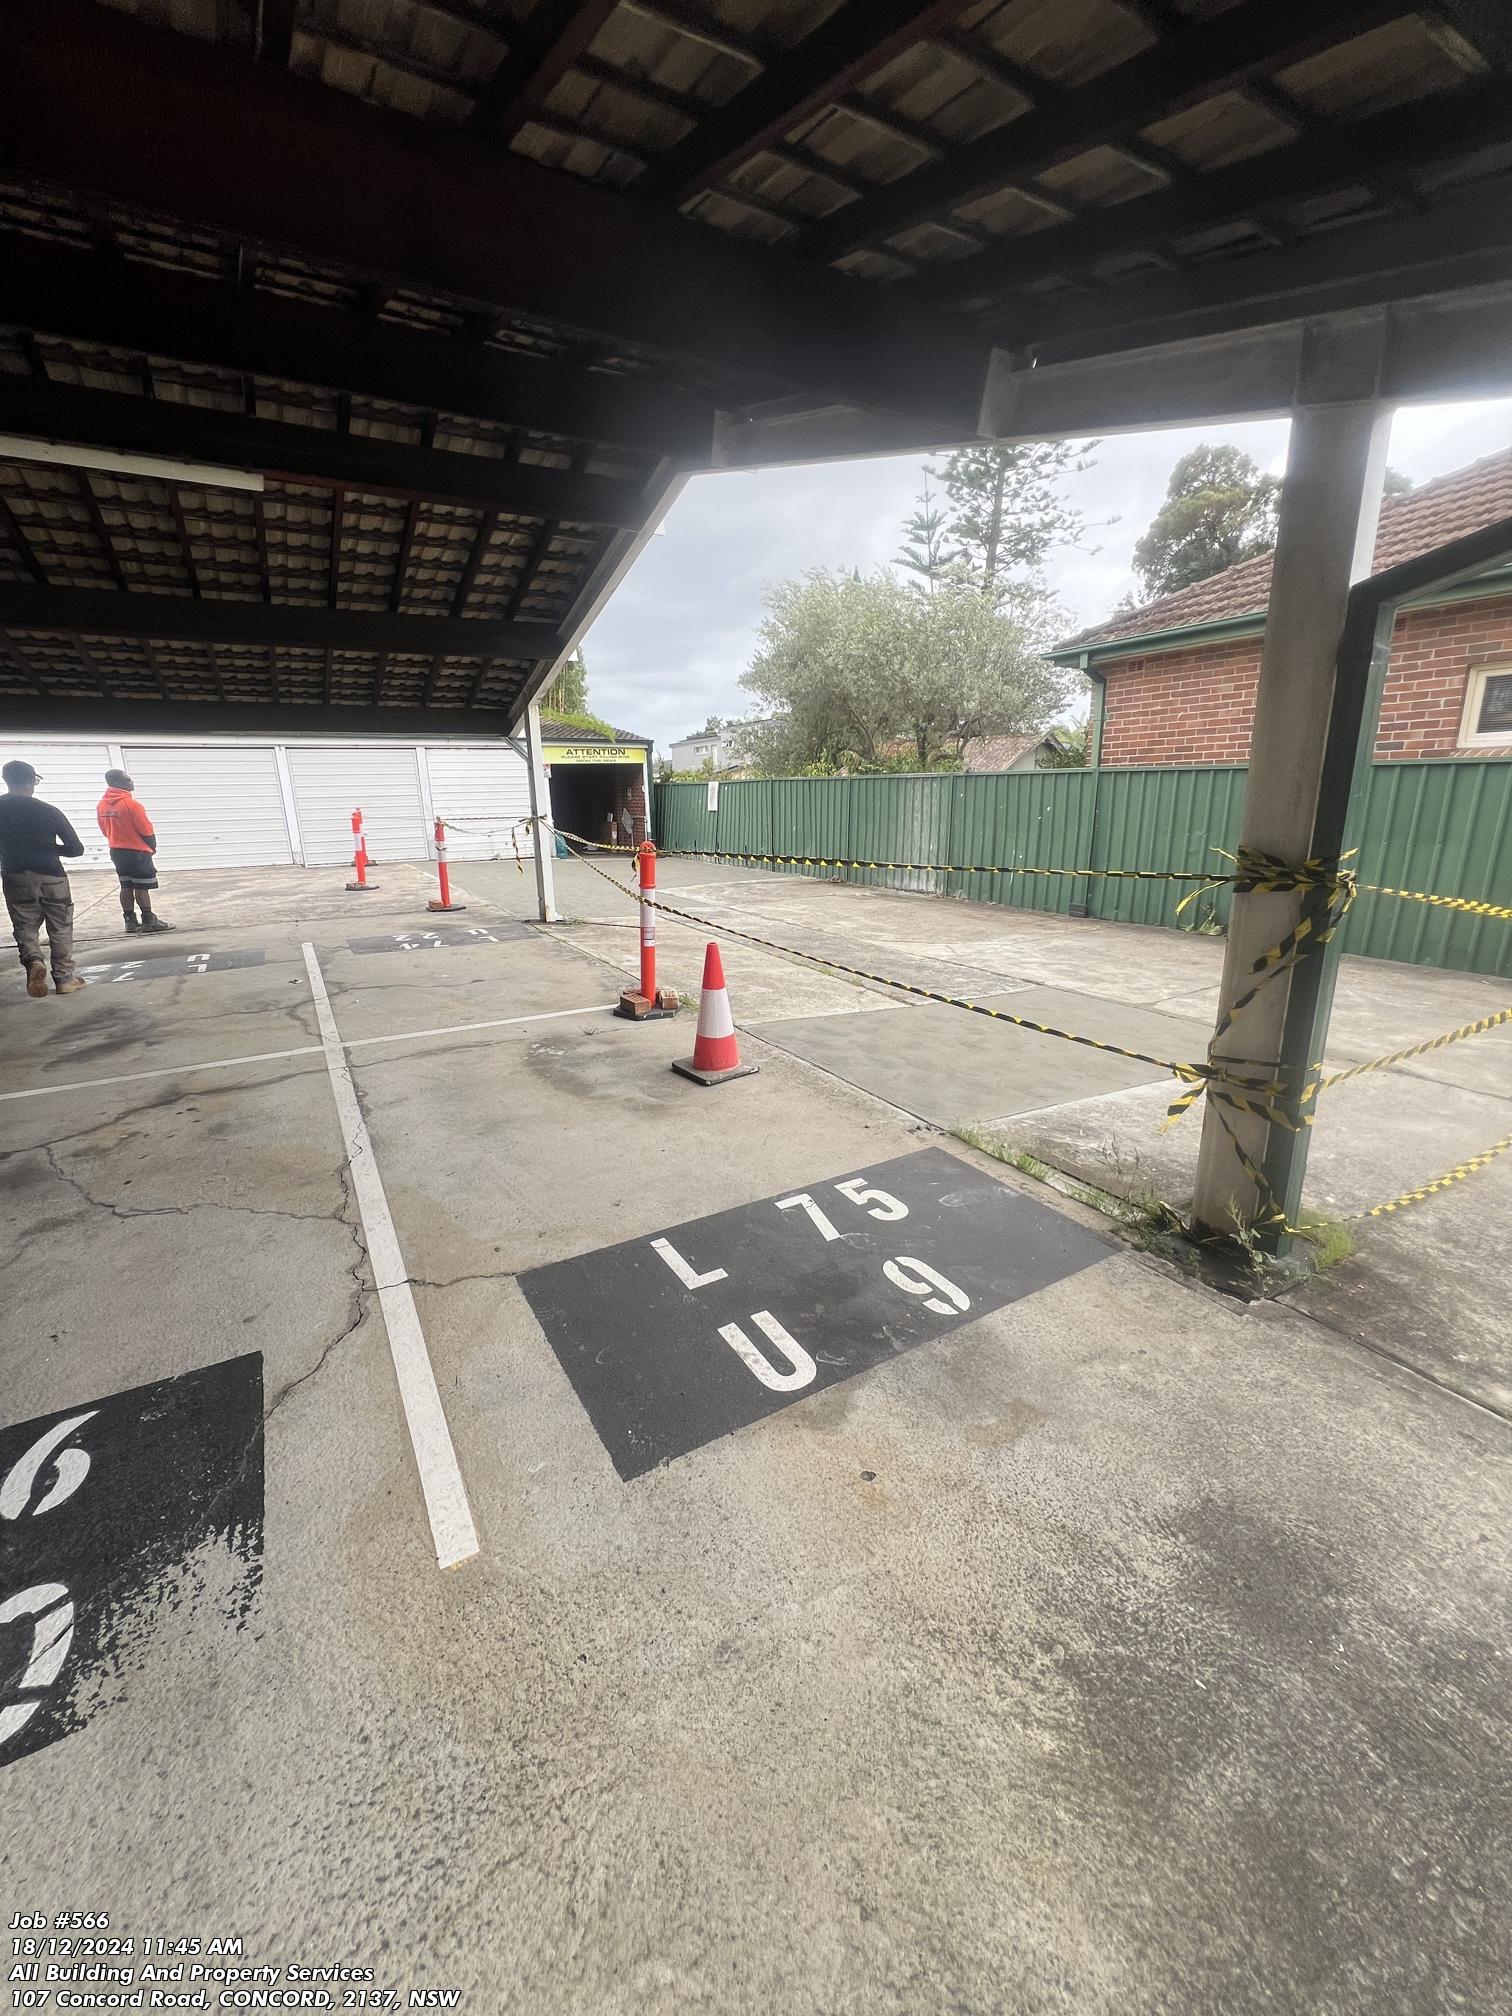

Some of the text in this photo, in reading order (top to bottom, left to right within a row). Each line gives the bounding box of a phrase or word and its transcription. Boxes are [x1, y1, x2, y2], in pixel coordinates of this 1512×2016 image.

[649, 1176, 910, 1291] L 75
[716, 1255, 971, 1392] U 9
